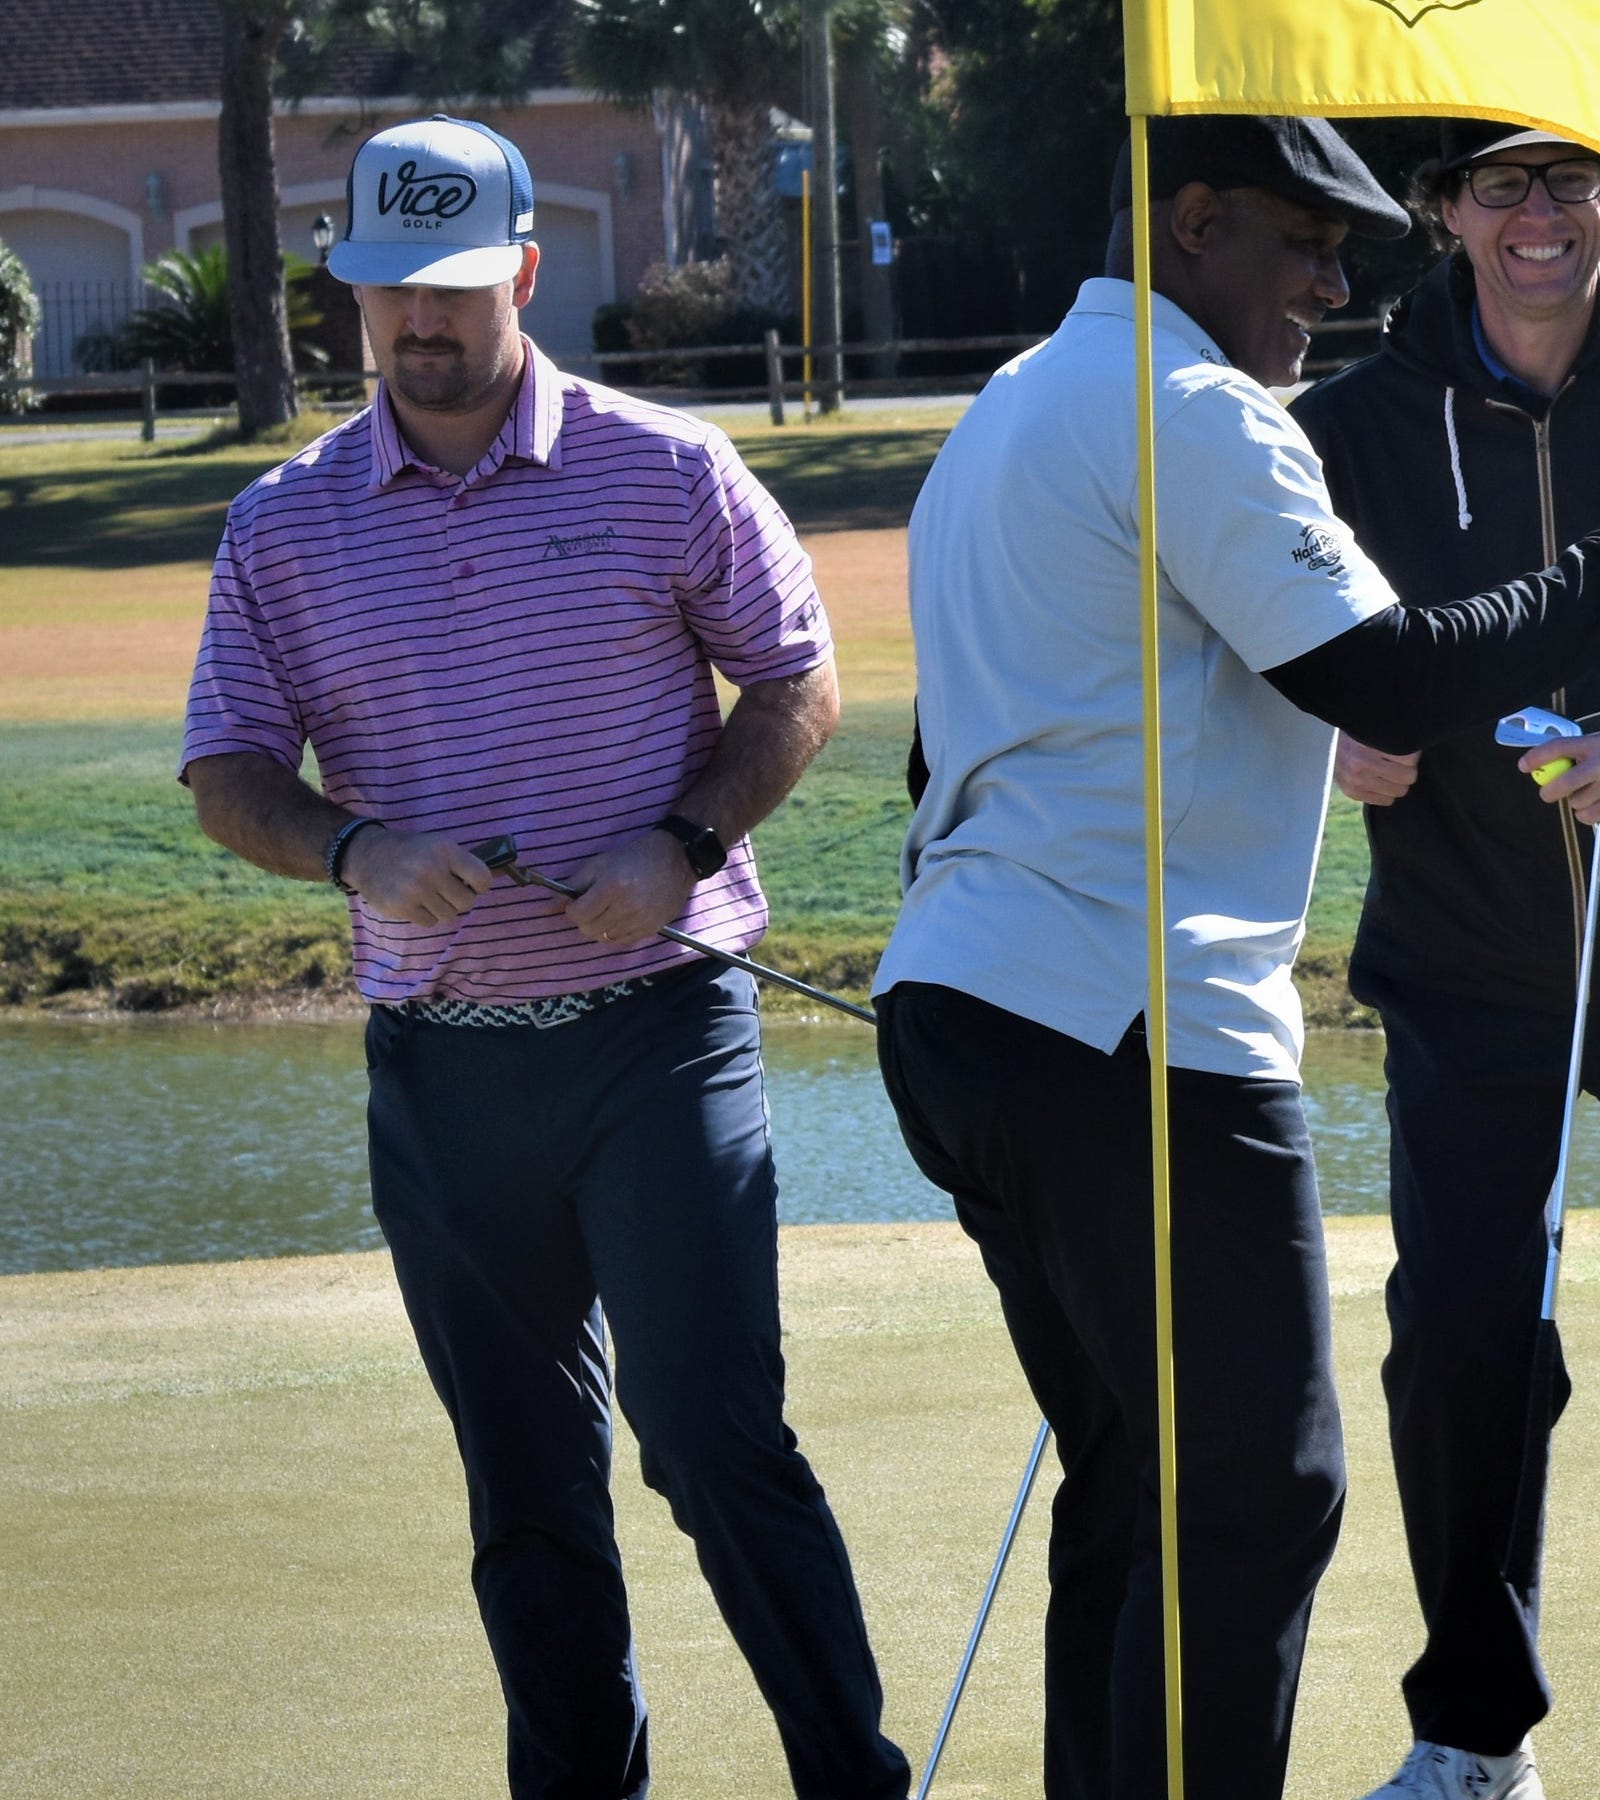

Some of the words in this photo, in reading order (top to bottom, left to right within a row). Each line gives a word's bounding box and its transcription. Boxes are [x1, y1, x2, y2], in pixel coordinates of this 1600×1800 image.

[378, 160, 477, 218] Vice
[403, 219, 443, 230] GOLF
[1291, 539, 1322, 563] Hard
